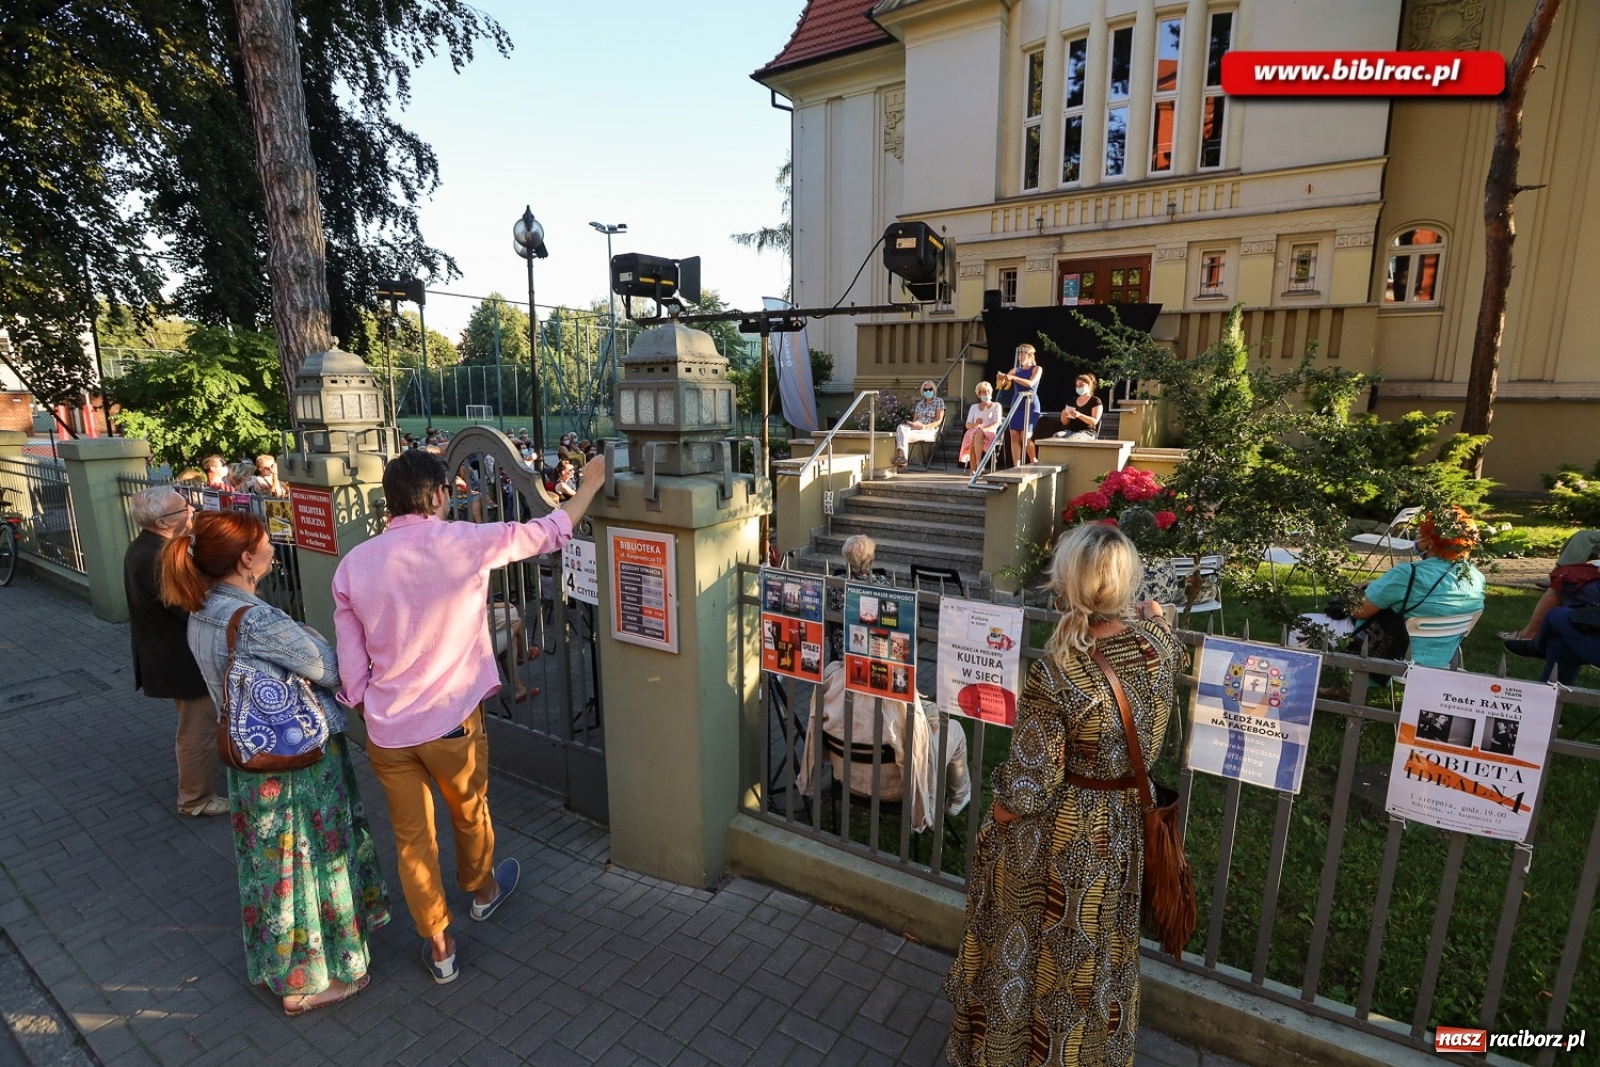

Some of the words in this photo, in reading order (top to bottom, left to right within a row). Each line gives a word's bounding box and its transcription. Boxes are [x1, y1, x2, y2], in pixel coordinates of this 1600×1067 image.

[299, 504, 326, 516] BIBLIOTEKA
[301, 516, 326, 528] PUBLICZNA
[620, 541, 661, 555] BIBLIOTEKA
[567, 572, 575, 591] 4
[847, 587, 872, 595] POLECAMY
[952, 643, 979, 653] REALIZACJA
[980, 649, 1003, 658] PROJEKTU
[957, 652, 1004, 670] KULTURA
[962, 668, 972, 678] W
[975, 670, 1003, 685] SIECI
[1440, 703, 1473, 712] zaprasza
[1488, 711, 1522, 720] spektakl
[1443, 693, 1475, 705] Teatr
[1480, 699, 1522, 714] RAWA
[1211, 718, 1225, 727] NA
[1228, 722, 1289, 739] FACEBOOKU
[1223, 711, 1252, 724] ŚLEDŹ
[1255, 718, 1276, 729] NAS
[1408, 748, 1525, 784] KOBIETA
[1418, 796, 1456, 810] sierpnia,
